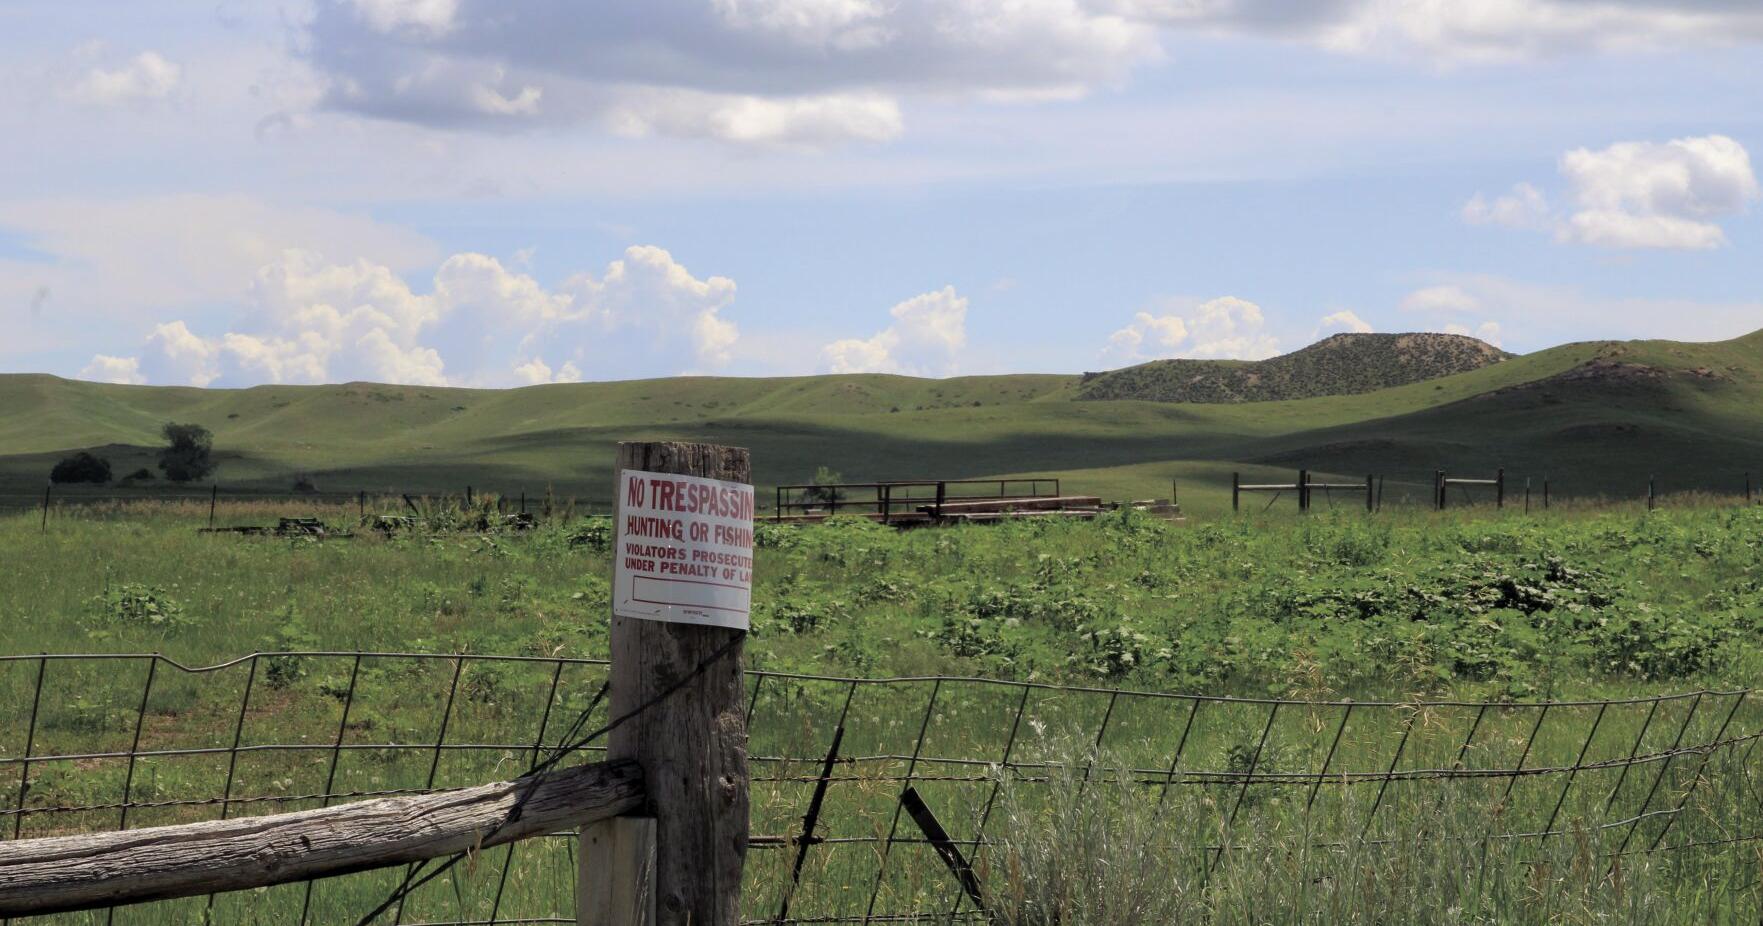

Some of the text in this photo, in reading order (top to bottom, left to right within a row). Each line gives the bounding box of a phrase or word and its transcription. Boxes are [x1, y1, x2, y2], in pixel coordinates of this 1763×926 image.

[627, 477, 753, 521] NO TRESPASSIN
[627, 515, 752, 549] HUNTING OR FISHIN
[625, 558, 655, 572] UNDER
[660, 561, 717, 578] PENALTY
[722, 568, 736, 580] OF
[626, 543, 752, 569] VIOLATORS PROSECUTE
